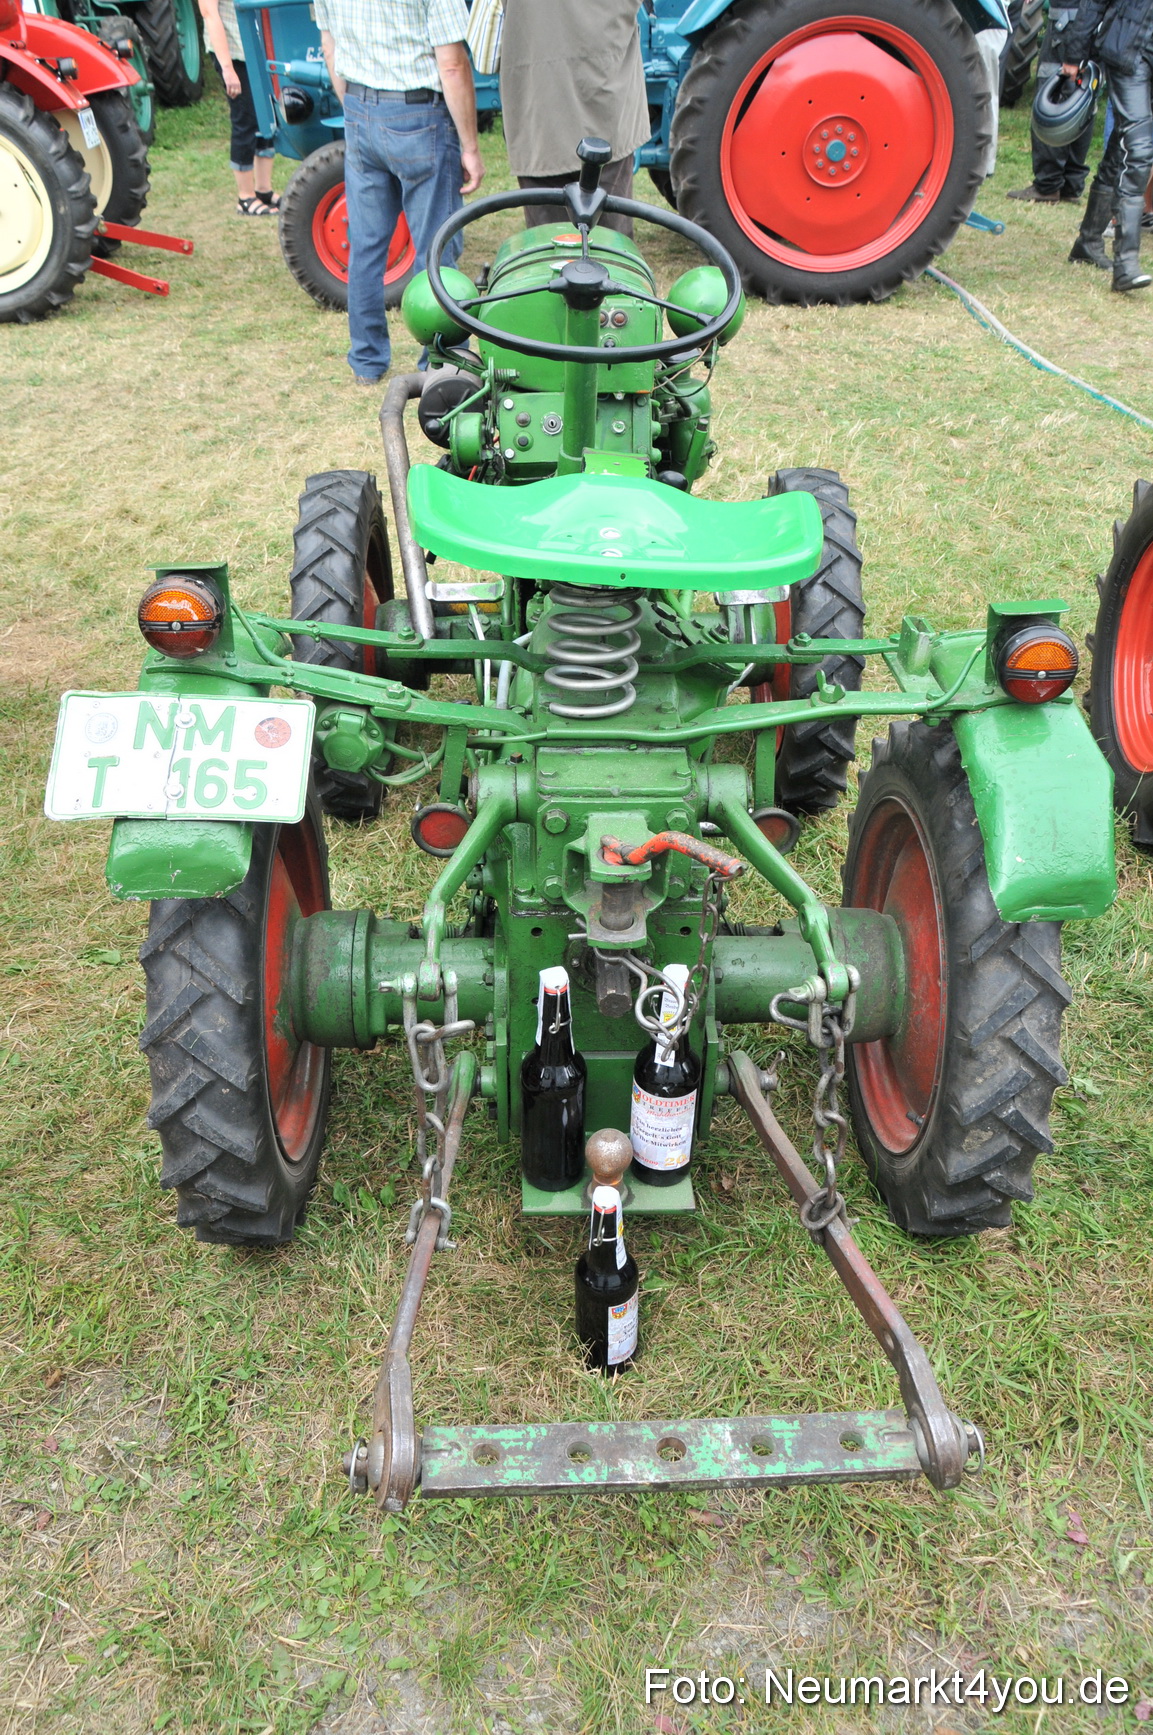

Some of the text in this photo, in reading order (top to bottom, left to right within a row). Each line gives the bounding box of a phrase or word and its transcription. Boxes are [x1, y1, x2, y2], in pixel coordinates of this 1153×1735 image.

[133, 701, 237, 753] NM
[87, 755, 268, 810] T 165
[641, 1094, 695, 1107] OLDTIMER
[650, 1139, 687, 1148] Mitwirken
